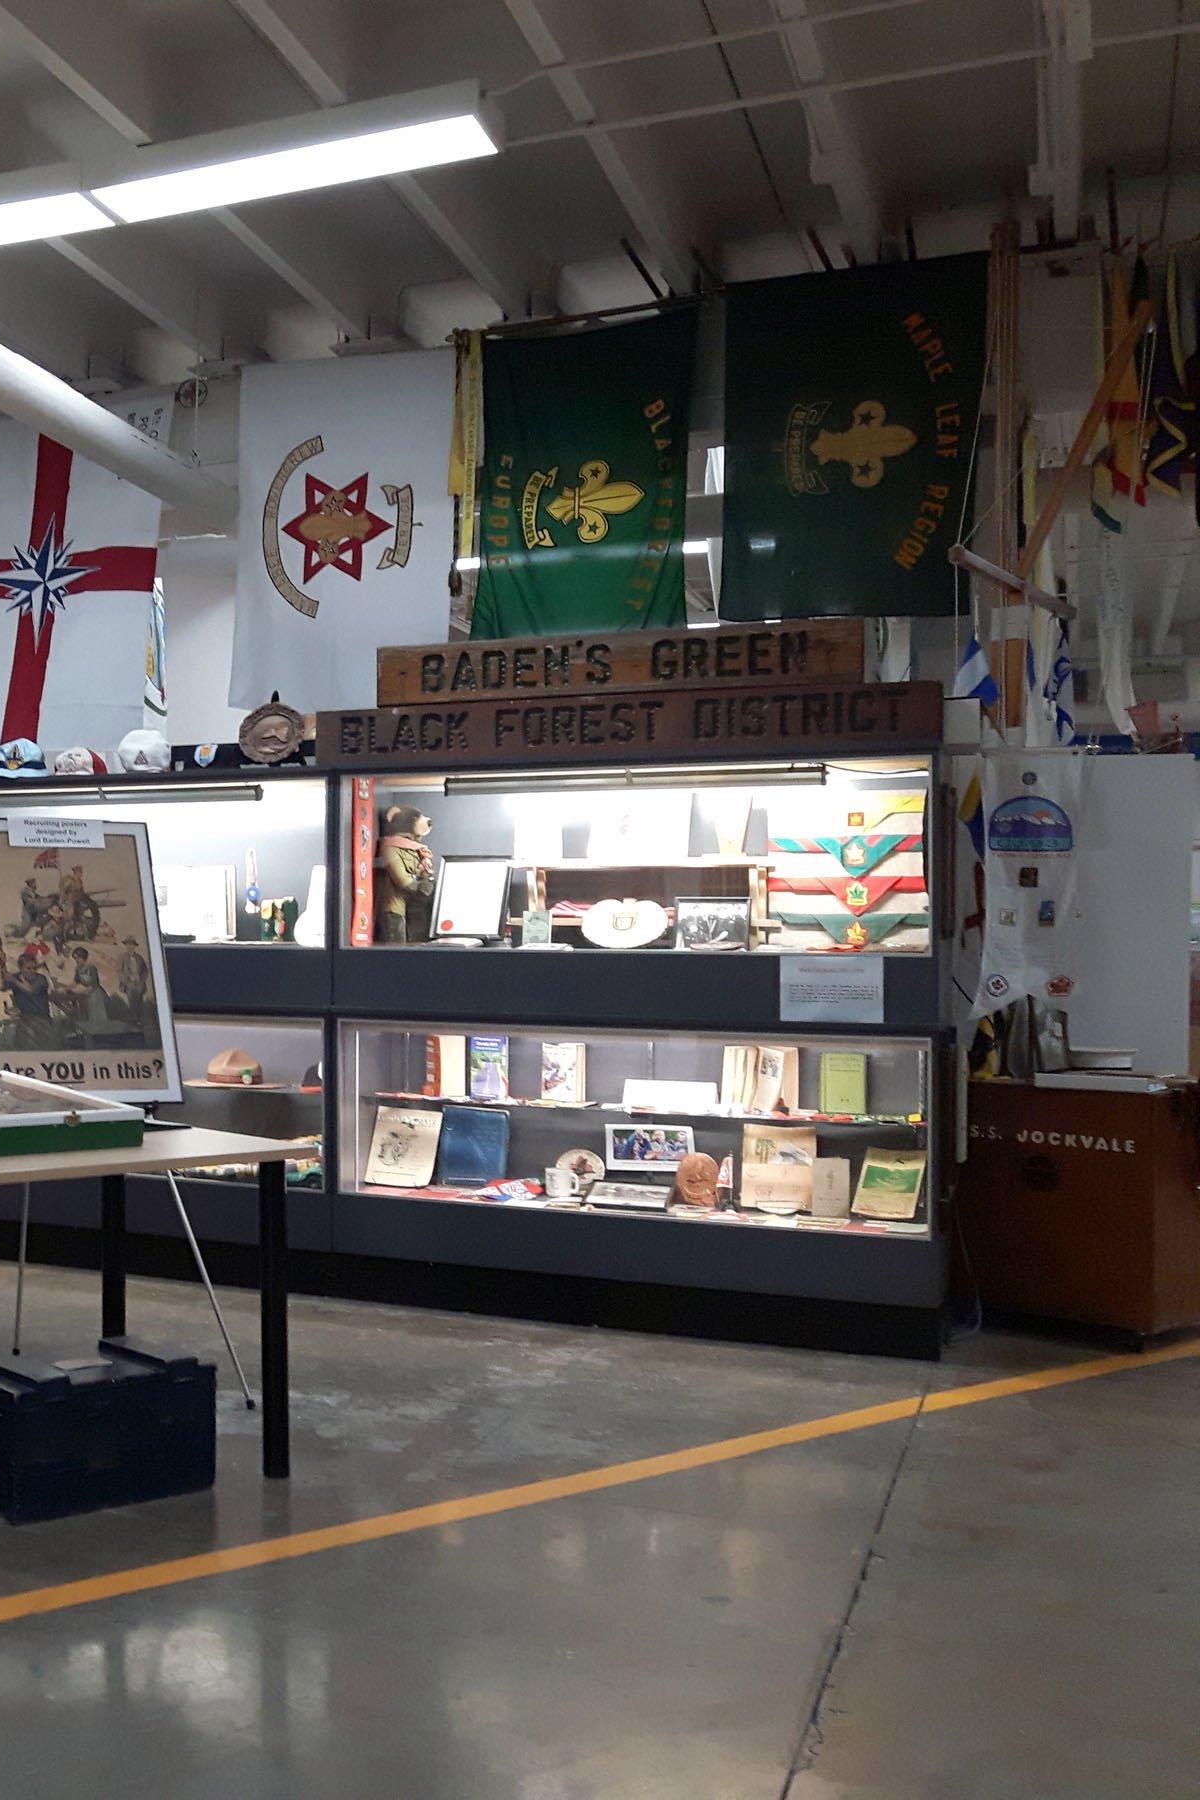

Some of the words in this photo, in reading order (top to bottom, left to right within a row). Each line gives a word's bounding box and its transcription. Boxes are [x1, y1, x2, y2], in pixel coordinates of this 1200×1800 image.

[901, 312, 953, 383] MAPLE
[934, 402, 961, 459] LEAF
[531, 474, 542, 489] BE
[523, 490, 538, 544] PREPARED
[421, 640, 612, 694] BADEN'S
[651, 631, 809, 681] GREEN
[340, 709, 470, 756] BLACK
[495, 700, 664, 750] FOREST
[693, 690, 903, 740] DISTRICT
[23, 819, 60, 828] Recruiting
[61, 820, 88, 828] posters
[35, 828, 67, 836] designed
[24, 836, 41, 844] Lord
[40, 1061, 85, 1081] YOU
[93, 1062, 111, 1080] in
[117, 1058, 164, 1080] this?
[1016, 1129, 1136, 1154] JOCKVALE
